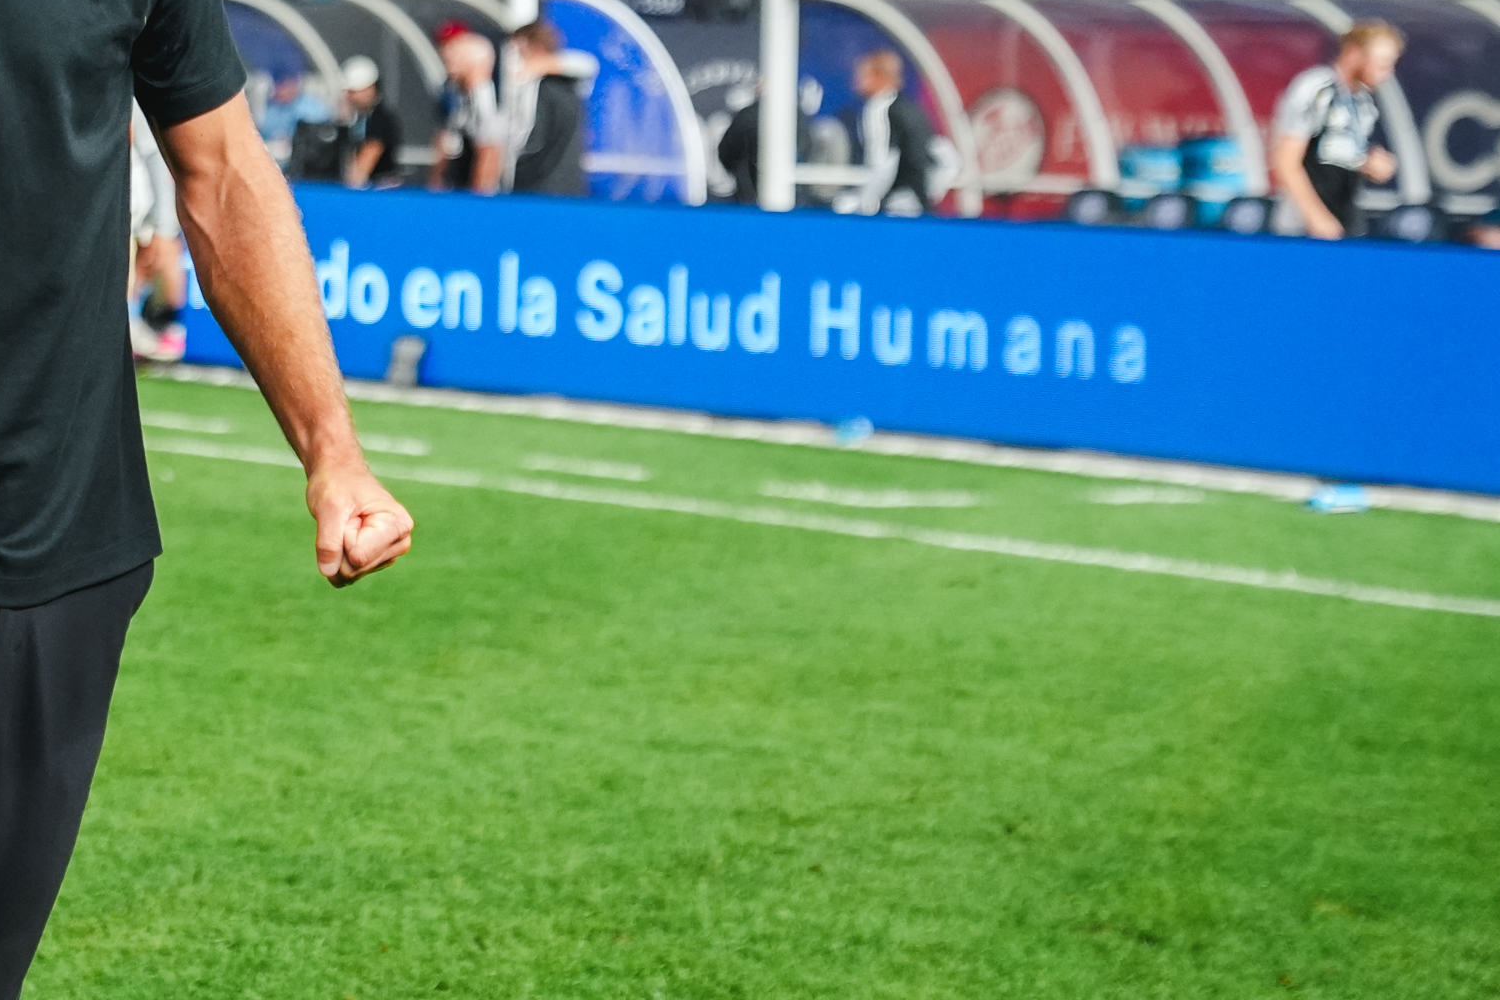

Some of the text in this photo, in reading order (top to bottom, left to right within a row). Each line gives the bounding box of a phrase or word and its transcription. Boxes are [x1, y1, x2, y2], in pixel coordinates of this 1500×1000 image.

[401, 266, 483, 331] en
[499, 250, 557, 338] la
[576, 259, 781, 355] Salud
[809, 279, 1148, 385] Humana
